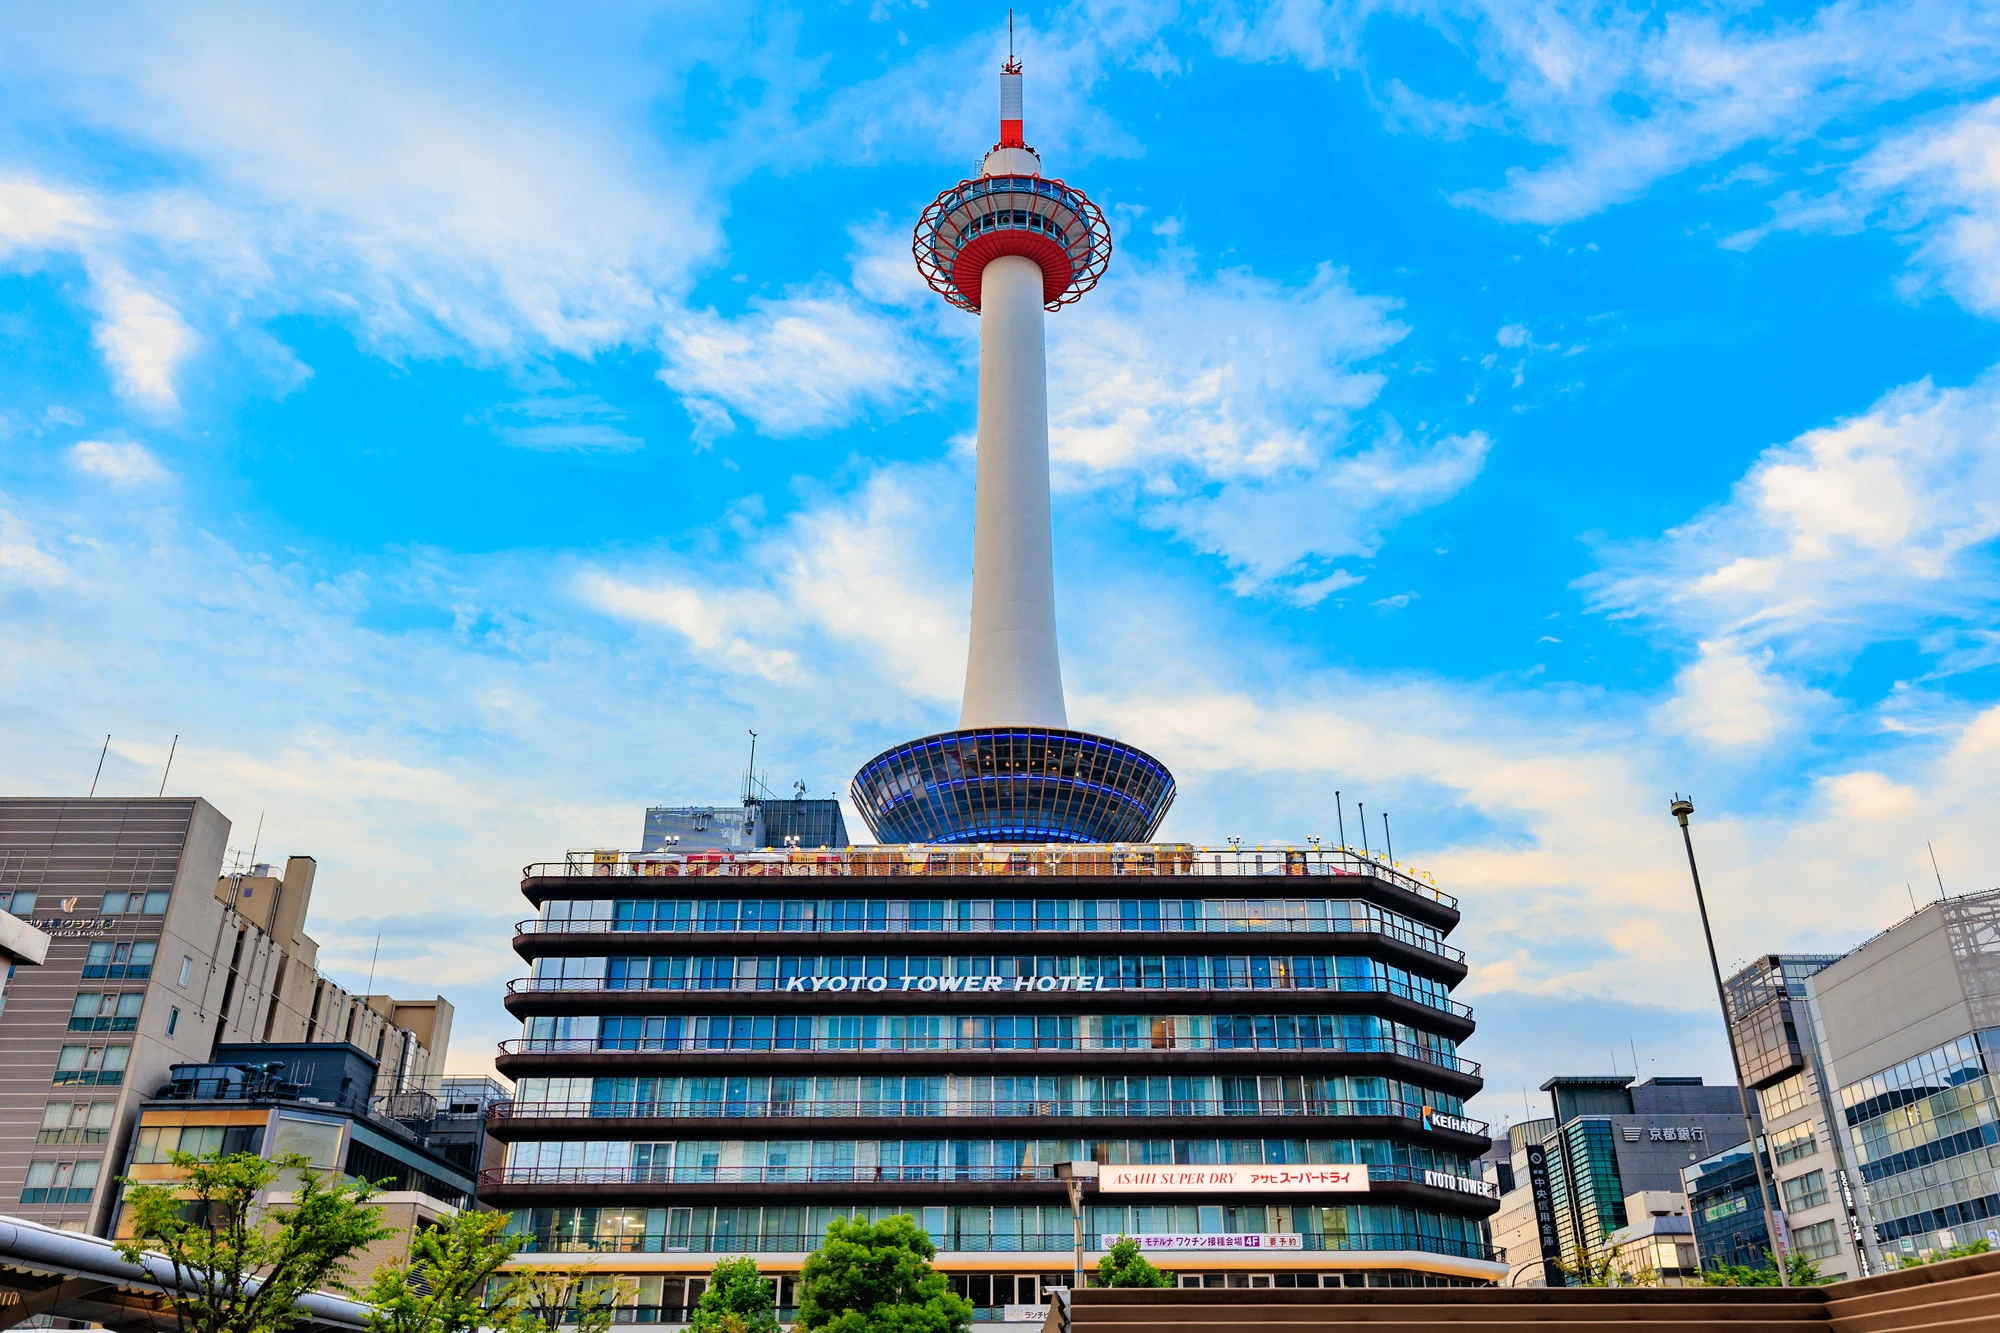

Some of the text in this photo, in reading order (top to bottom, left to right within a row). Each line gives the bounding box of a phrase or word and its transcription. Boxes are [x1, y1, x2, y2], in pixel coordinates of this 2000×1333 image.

[785, 976, 1112, 992] KYOTO TOWER HOTEL
[1431, 1112, 1476, 1134] KEIHAN
[1648, 1126, 1704, 1141] 京都銀行
[1112, 1172, 1238, 1185] ASAHI SUPER DRY
[1424, 1169, 1489, 1196] KYOTO TOWER
[1145, 1237, 1174, 1247] モデルナ
[1244, 1236, 1259, 1247] 4F
